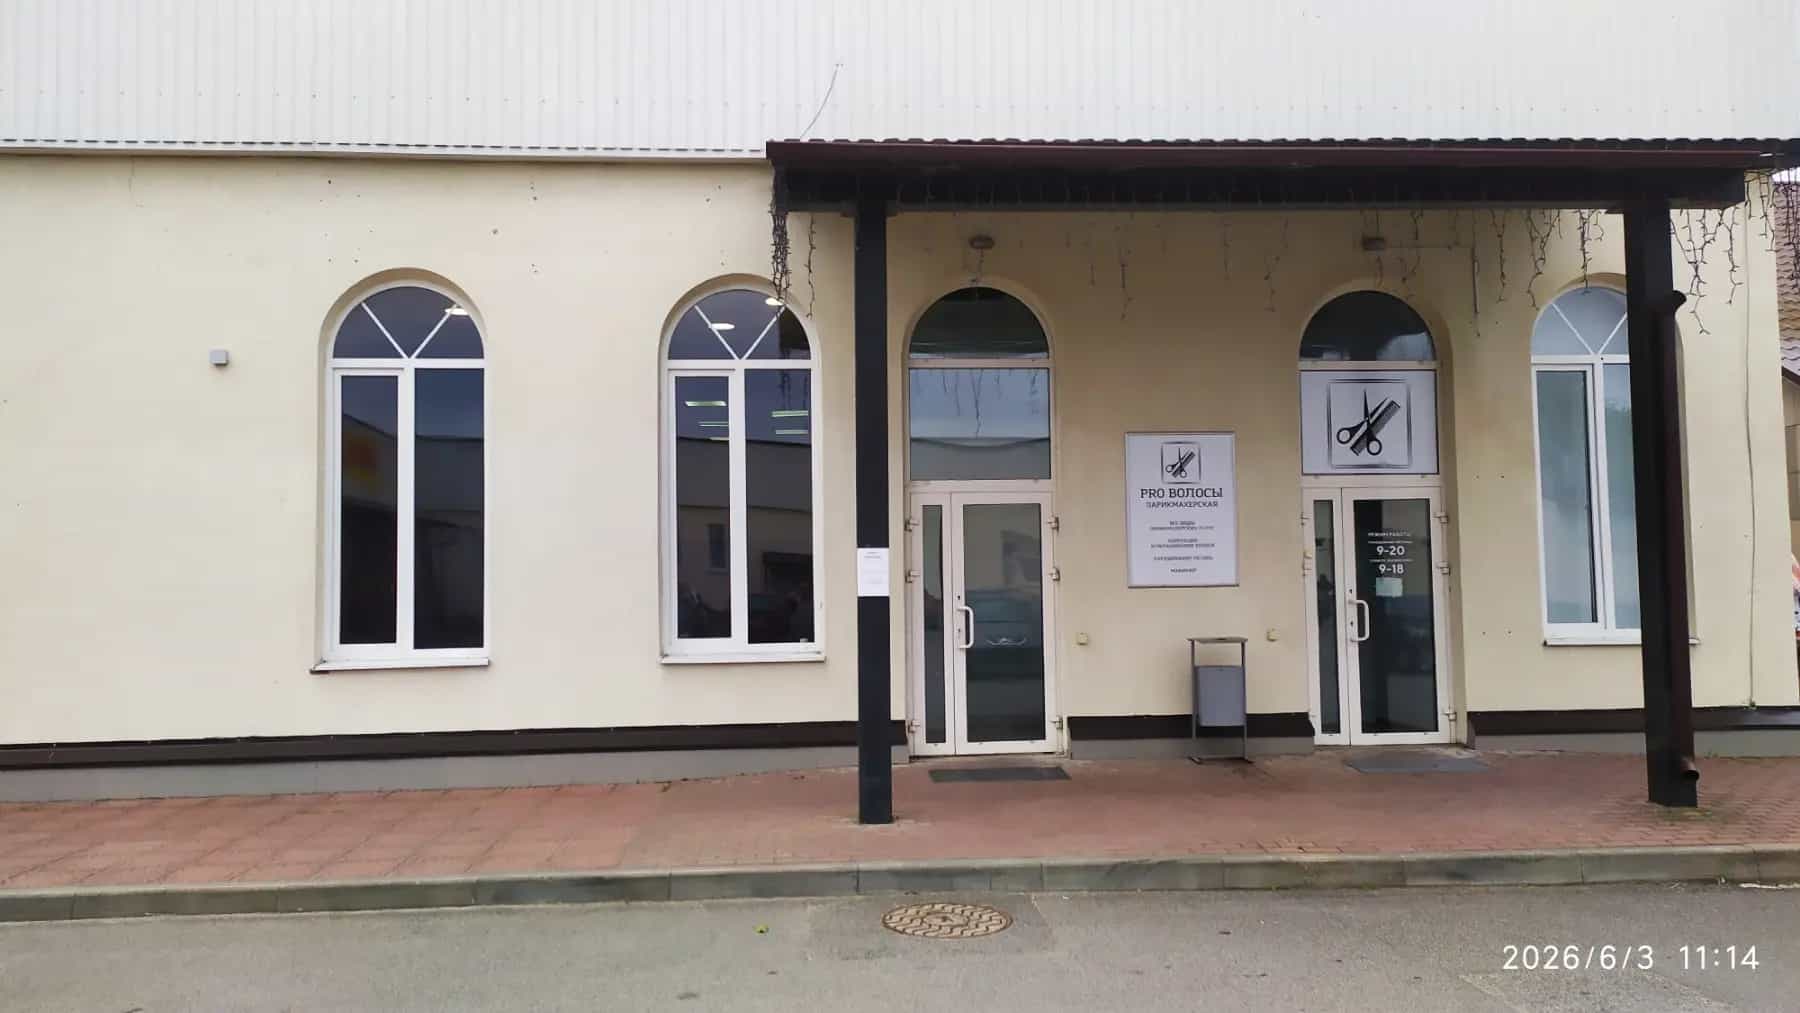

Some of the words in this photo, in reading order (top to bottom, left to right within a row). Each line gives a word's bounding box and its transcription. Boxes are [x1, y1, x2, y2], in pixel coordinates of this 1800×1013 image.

[1140, 488, 1165, 498] PRO
[1168, 487, 1224, 498] ВОЛОСЫ
[1376, 545, 1405, 556] 9-20
[1378, 563, 1404, 574] 9-18
